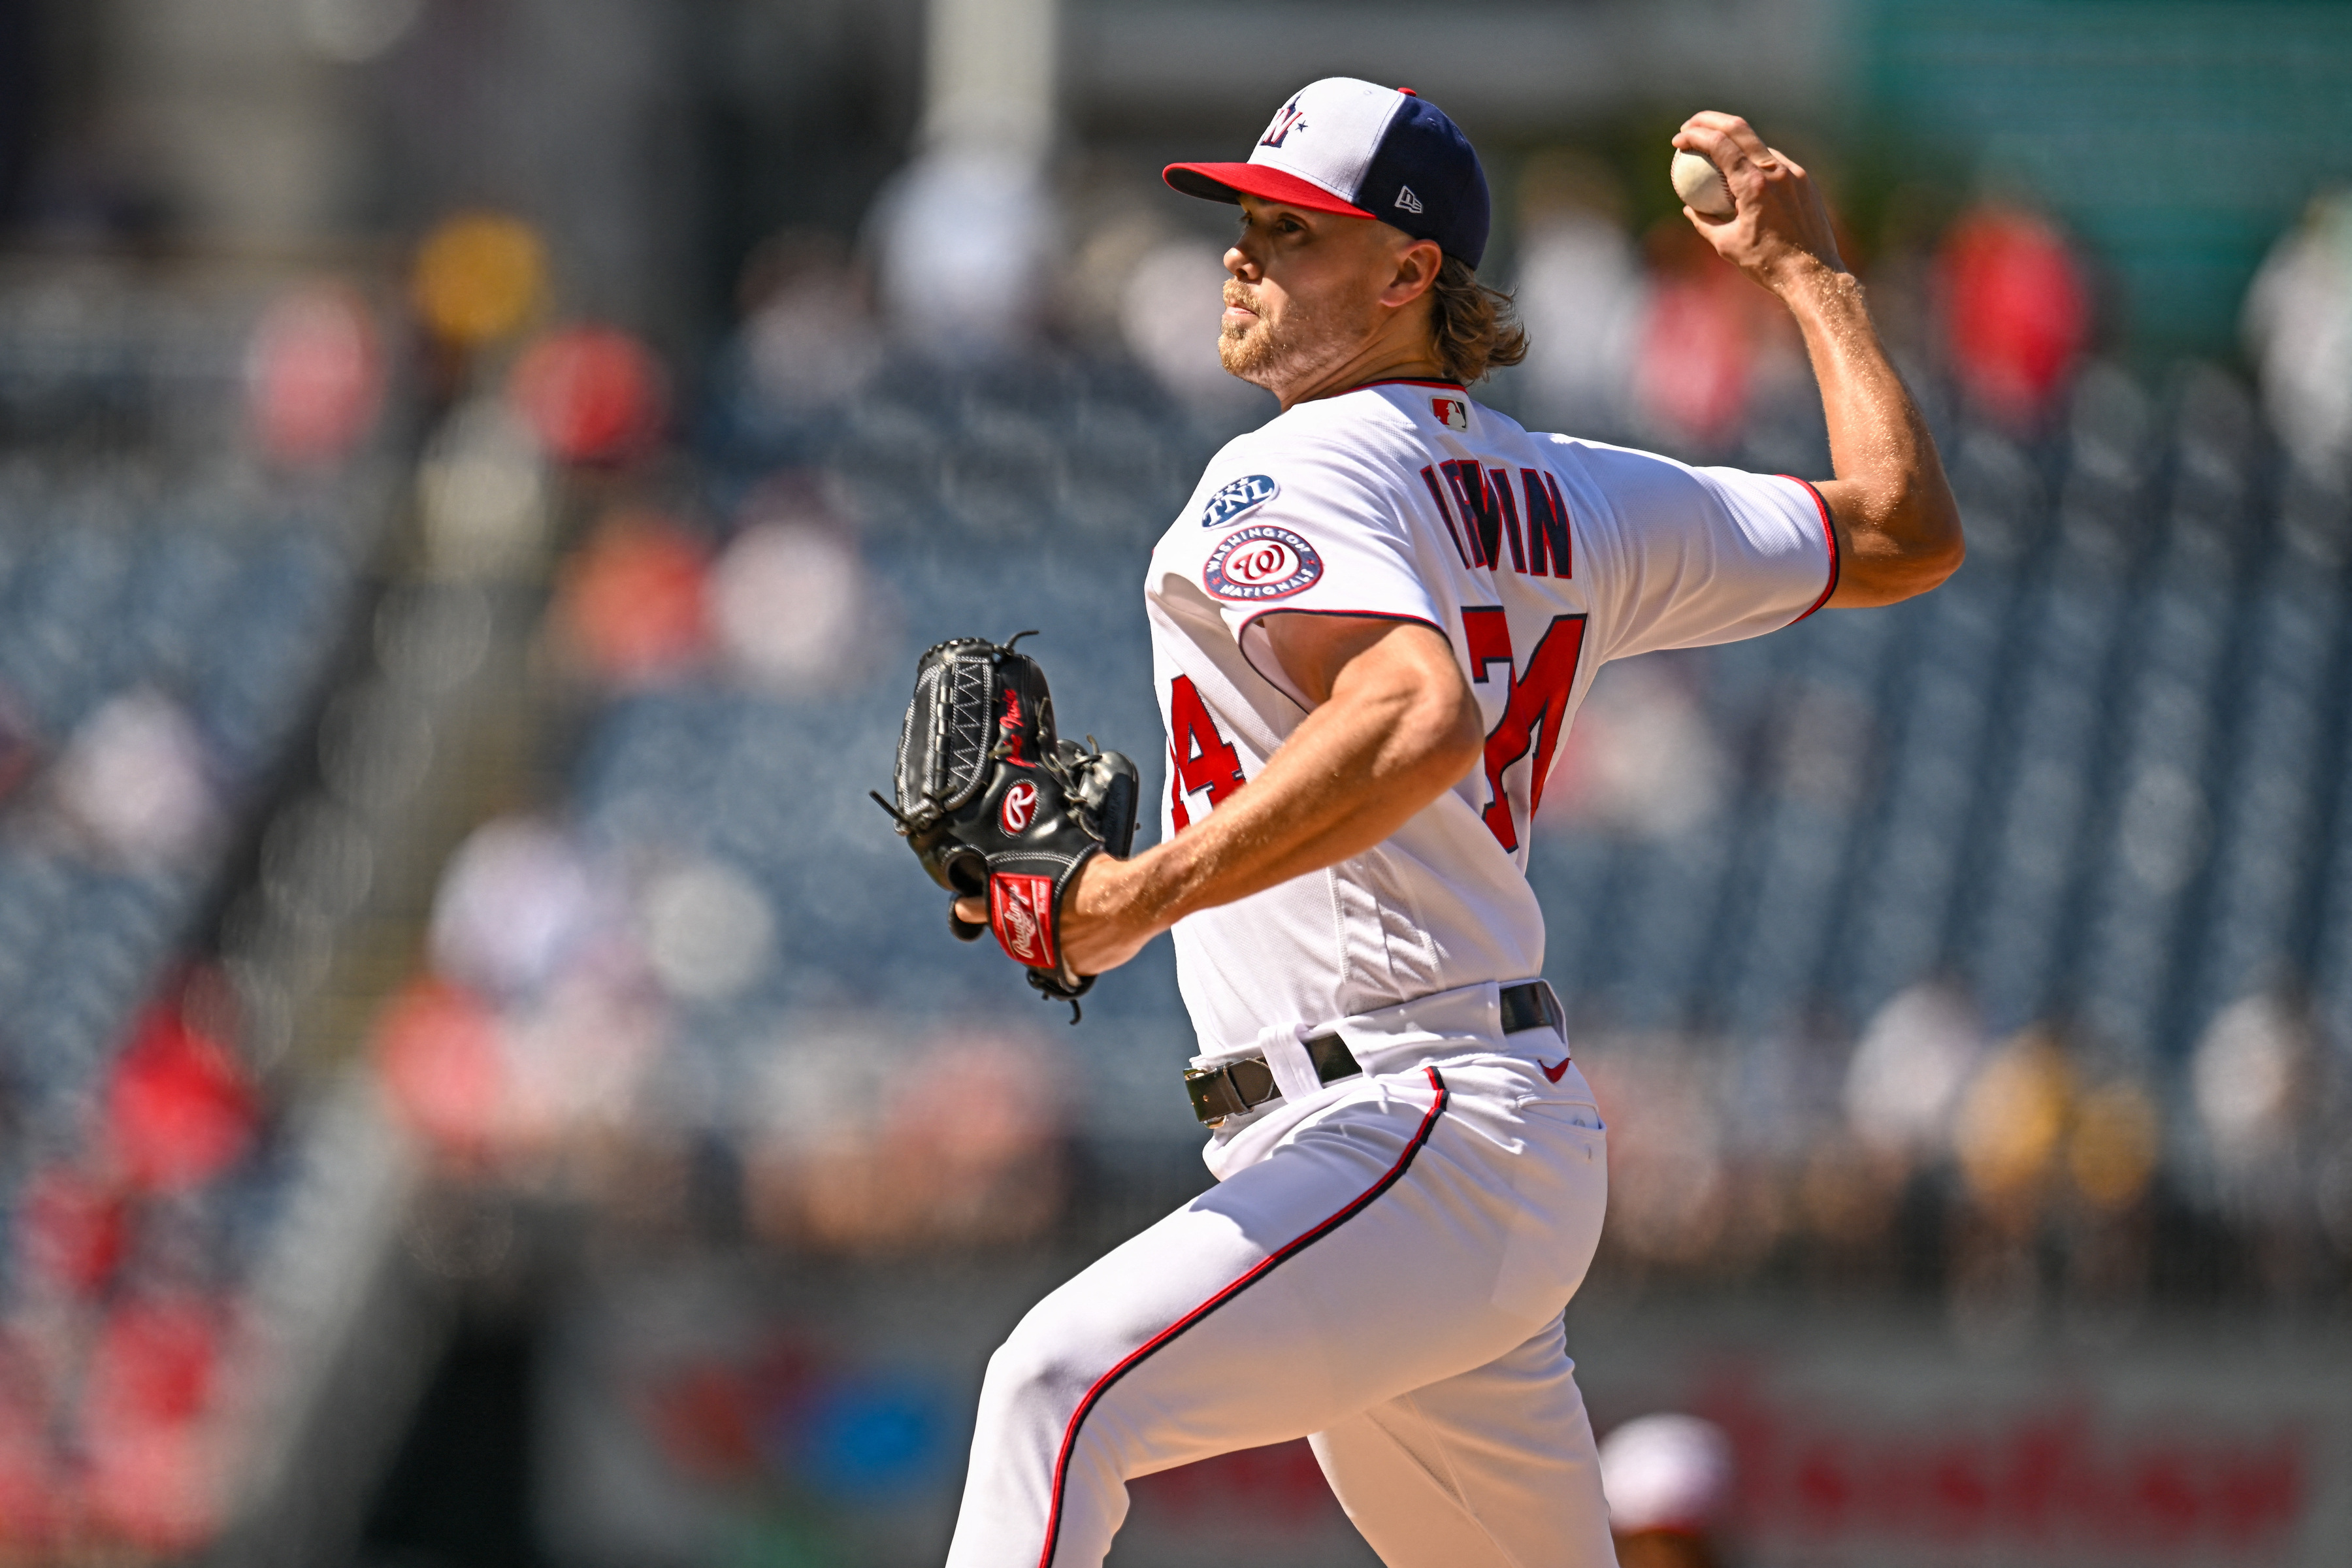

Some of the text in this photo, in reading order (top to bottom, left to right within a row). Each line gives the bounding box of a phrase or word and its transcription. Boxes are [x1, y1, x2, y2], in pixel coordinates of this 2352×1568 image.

[1207, 527, 1312, 572] WASHINGTON
[1420, 459, 1572, 580] IRVIN
[1218, 568, 1315, 597] NATIONALS
[1460, 605, 1588, 853] 74
[1005, 785, 1036, 832] R
[1004, 883, 1036, 959] Rawlings
